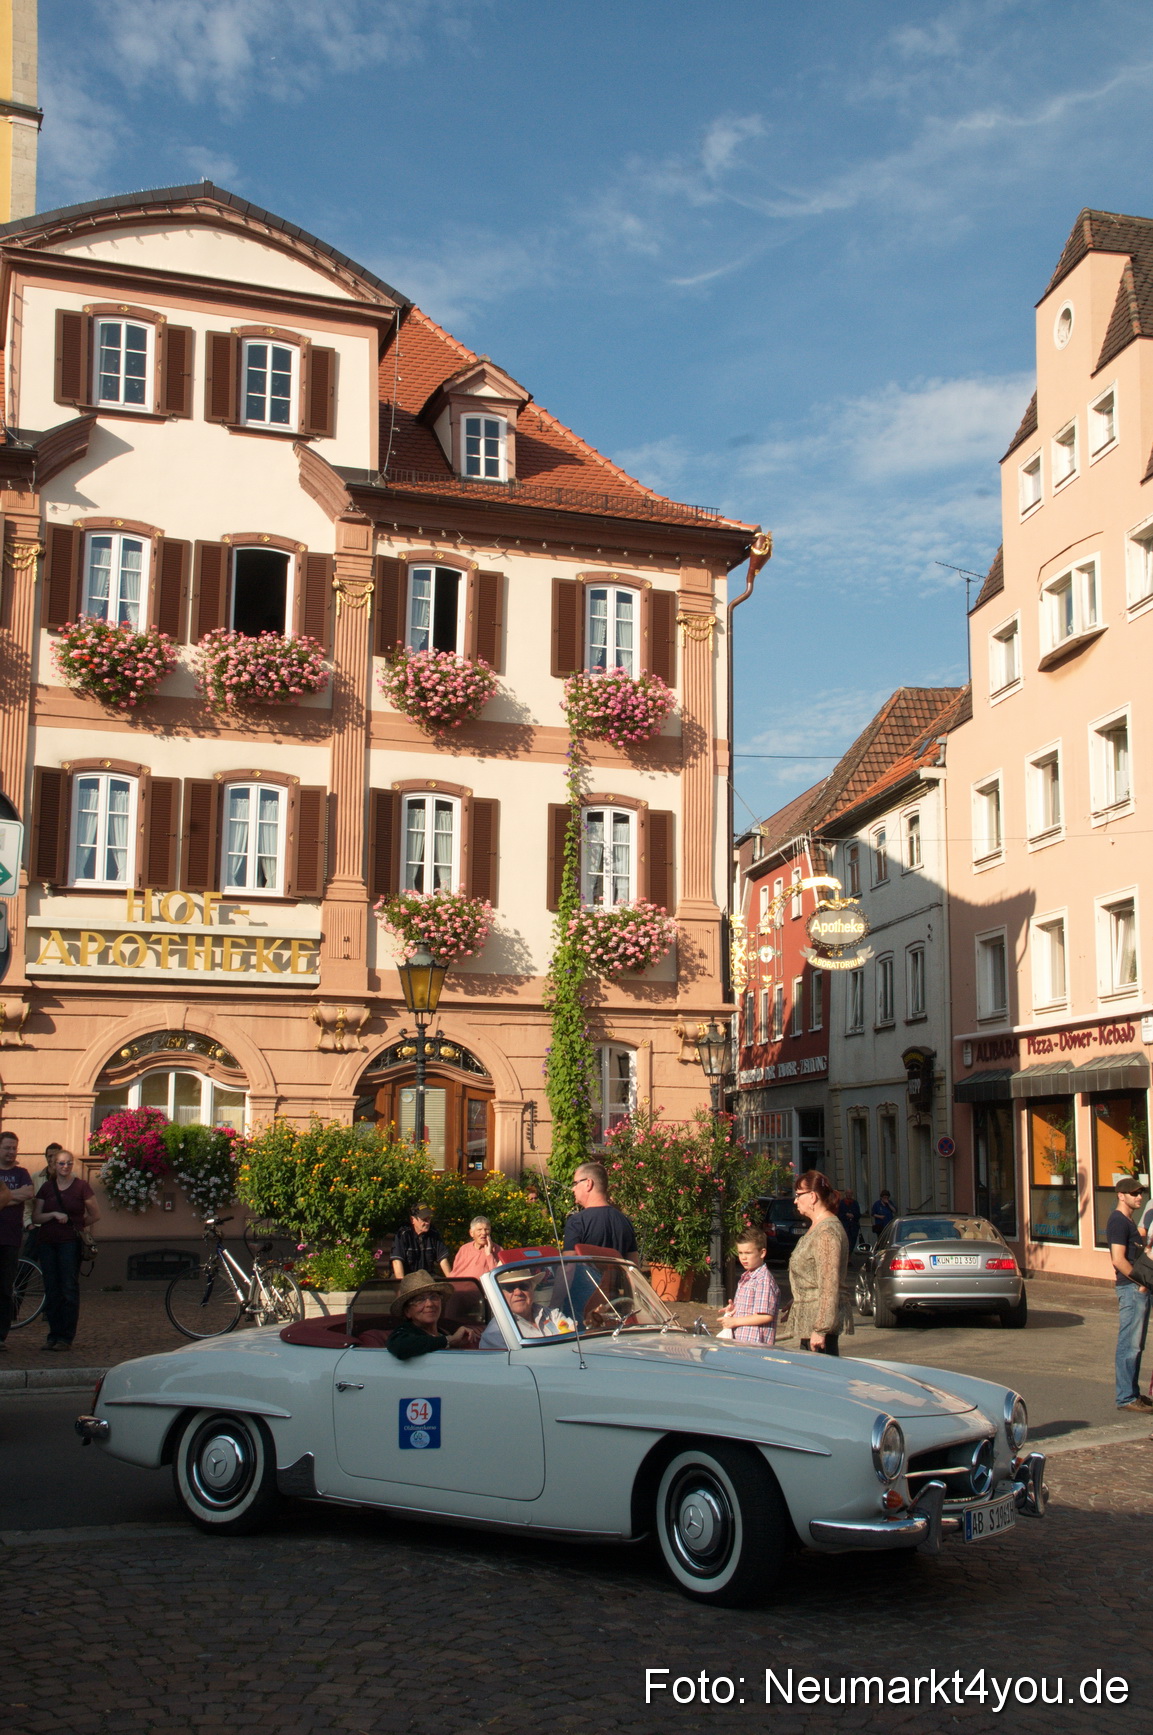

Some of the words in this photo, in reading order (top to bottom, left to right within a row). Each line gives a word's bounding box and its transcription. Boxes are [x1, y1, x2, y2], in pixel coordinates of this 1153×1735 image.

[810, 919, 865, 936] Apotheke
[35, 930, 316, 975] APOTHEKE
[808, 955, 865, 969] LABORATORIUM
[1027, 1022, 1136, 1055] Pizza-Döner-Kebab
[410, 1402, 428, 1420] 54
[973, 1512, 983, 1534] AB
